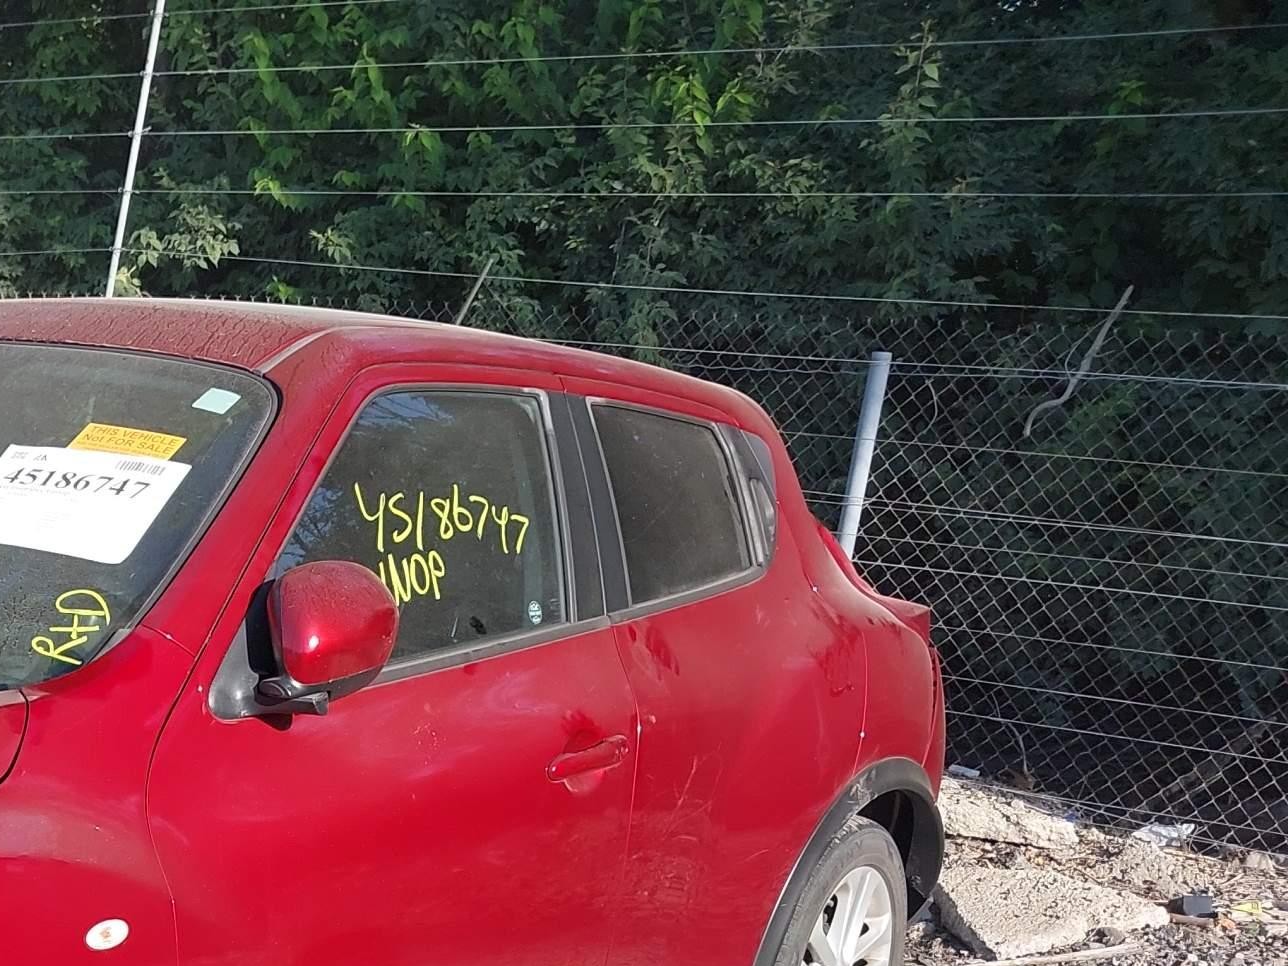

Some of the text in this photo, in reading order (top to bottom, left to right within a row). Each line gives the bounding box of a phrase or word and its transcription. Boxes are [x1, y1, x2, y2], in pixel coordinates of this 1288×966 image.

[90, 426, 178, 447] THIS VEHICLE
[106, 436, 135, 447] FOR
[137, 442, 173, 455] SALE
[4, 467, 152, 499] 45186747
[32, 589, 111, 665] RHD
